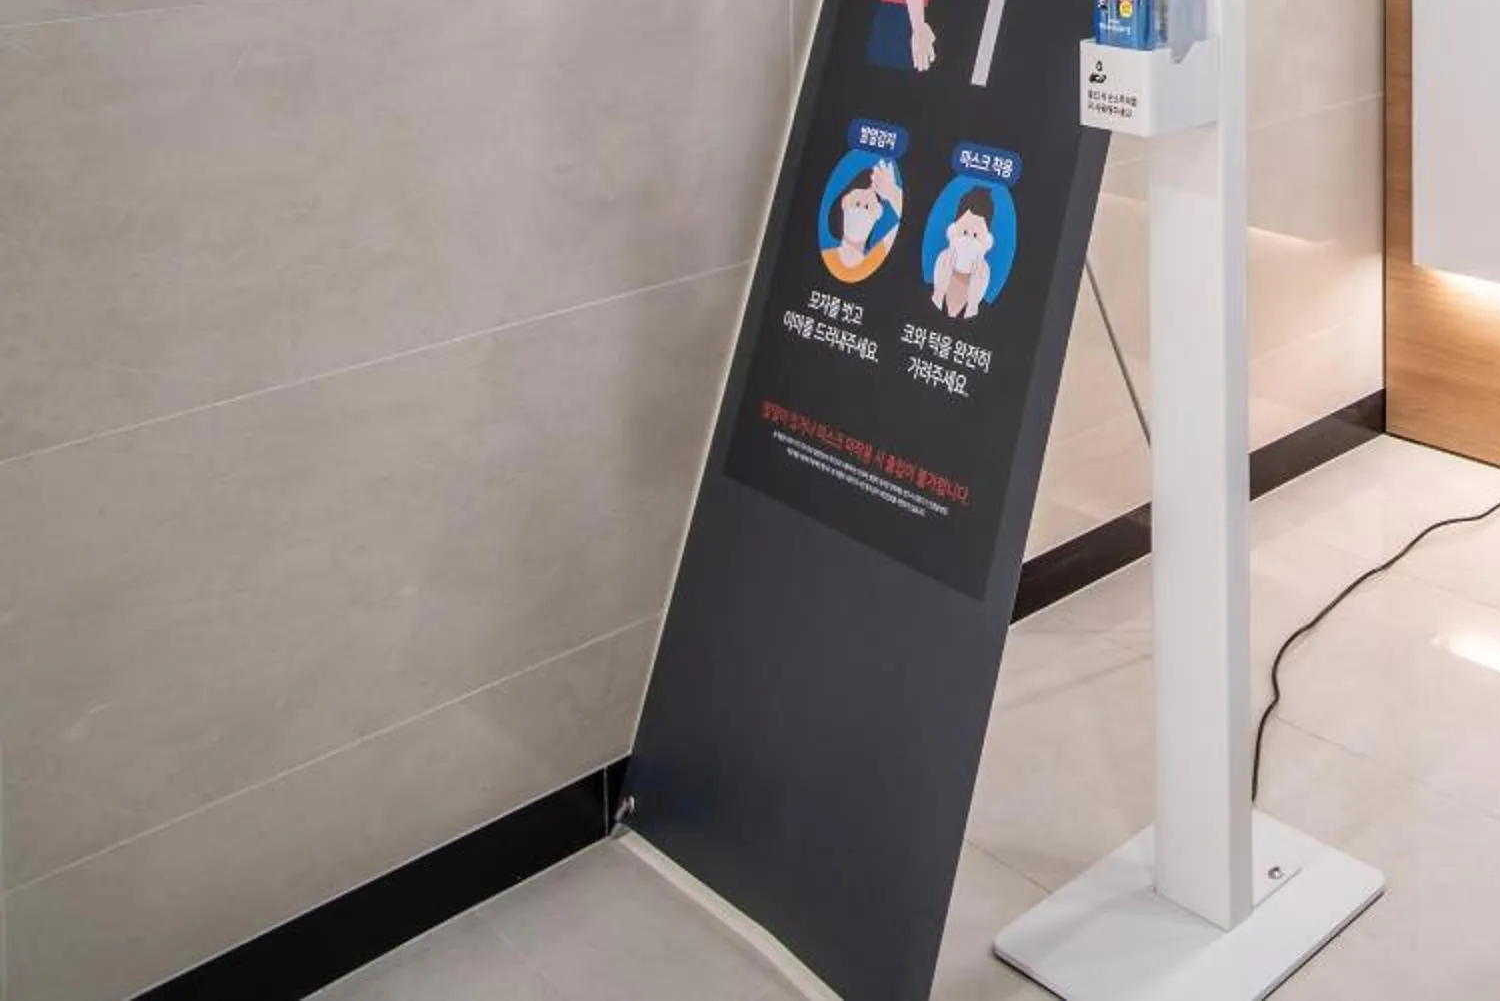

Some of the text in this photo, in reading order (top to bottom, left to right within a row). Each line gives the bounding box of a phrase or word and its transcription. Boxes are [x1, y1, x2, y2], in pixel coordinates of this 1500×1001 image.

[859, 125, 897, 150] 발열감지
[960, 150, 1013, 178] 마스크 착용
[808, 290, 864, 325] 모자를 벗고
[783, 310, 815, 339] 이마를
[900, 323, 993, 374] 코와 턱을 완전히
[907, 356, 969, 398] 가려주세요
